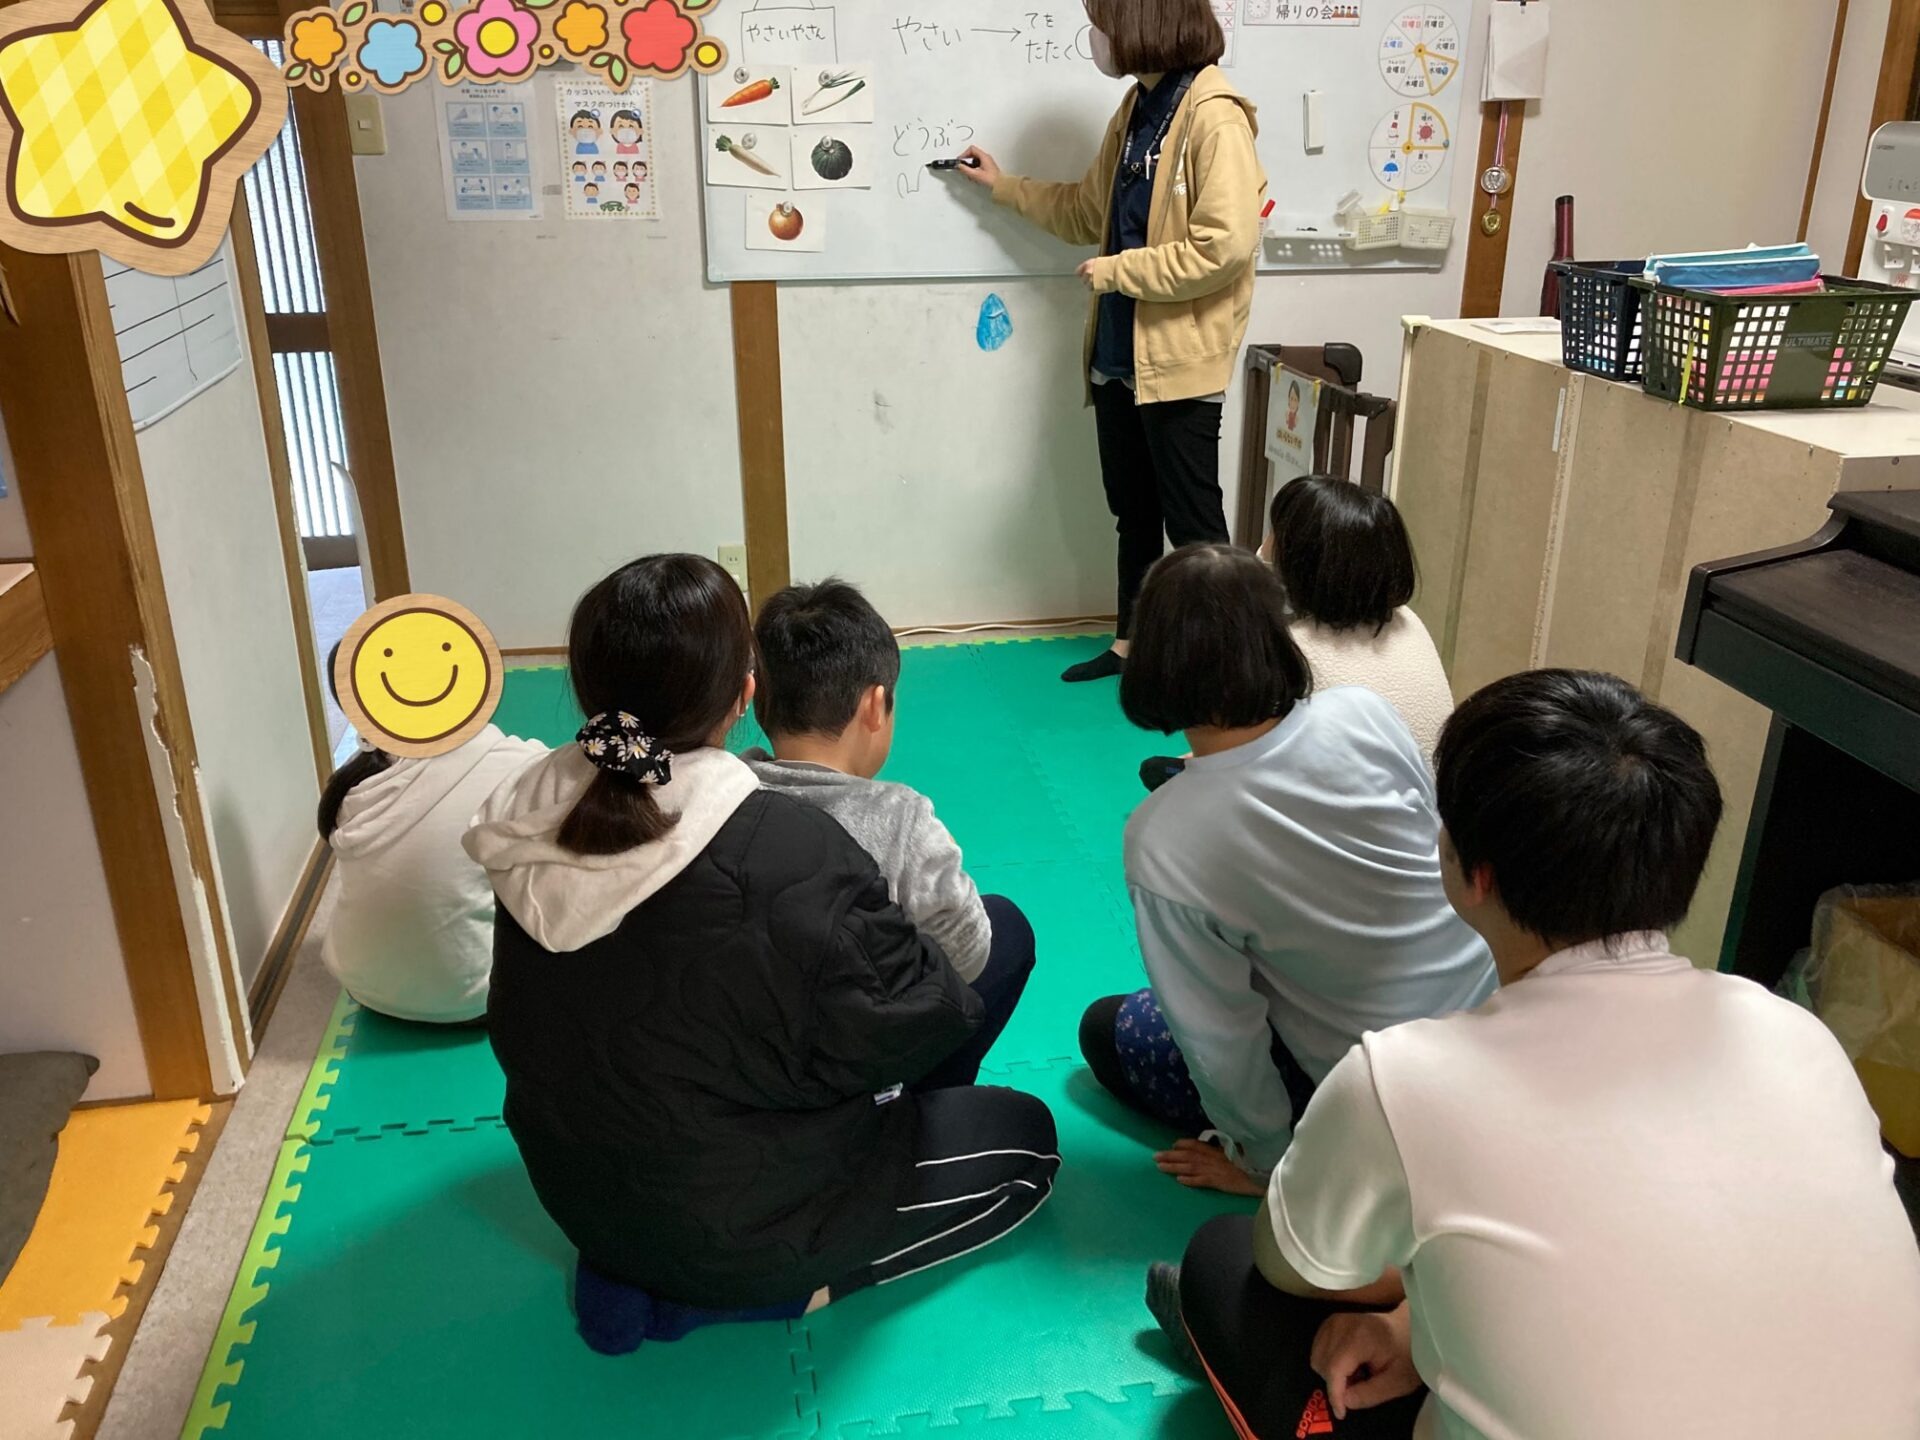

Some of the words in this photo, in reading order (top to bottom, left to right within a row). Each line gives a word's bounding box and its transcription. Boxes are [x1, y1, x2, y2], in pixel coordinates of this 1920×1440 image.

[1276, 4, 1333, 20] 帰りの会
[1424, 20, 1444, 28] 月曜日
[745, 23, 826, 43] やさいやさん
[892, 16, 961, 55] やさい
[1025, 39, 1073, 63] たたく
[1383, 40, 1403, 48] 土曜日
[1436, 42, 1455, 50] 火曜日
[574, 101, 637, 109] マスクのつけかた
[893, 117, 974, 157] どうぶつ
[1785, 336, 1833, 347] ULTIMATE
[1296, 1389, 1323, 1439] adidas
